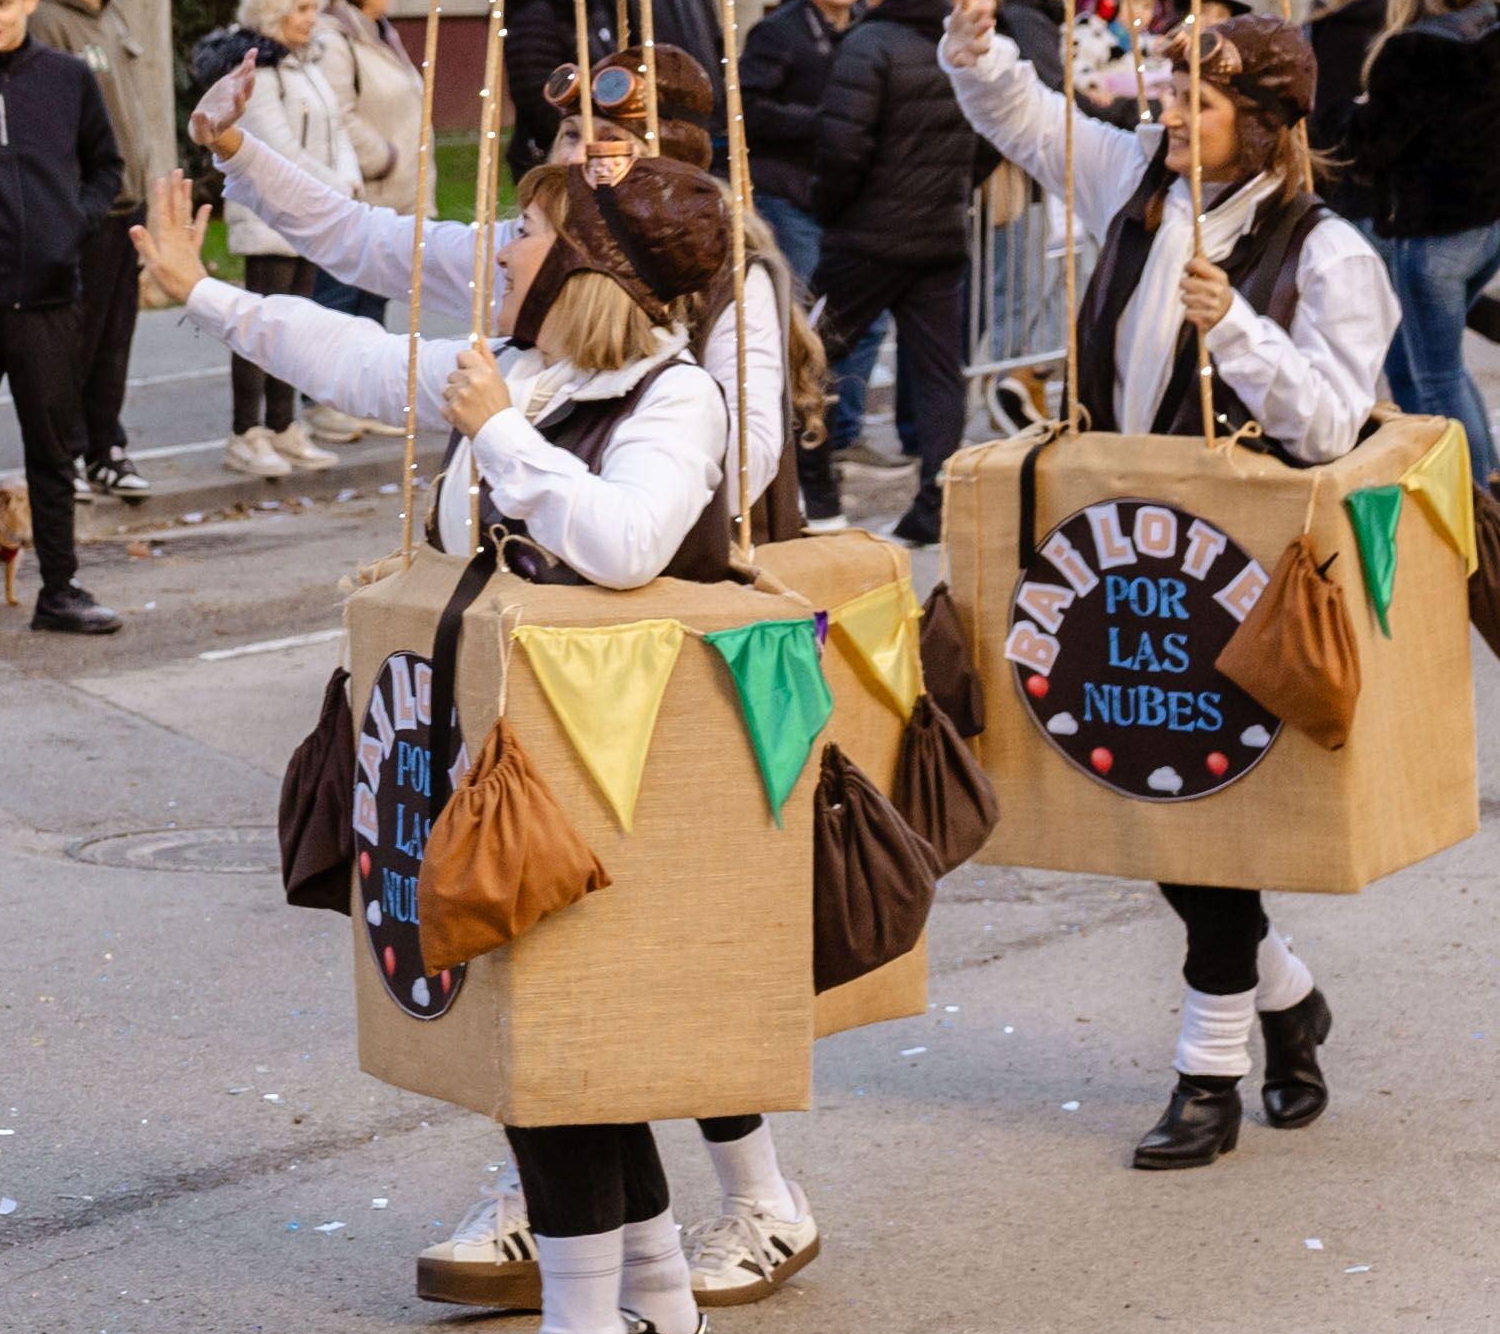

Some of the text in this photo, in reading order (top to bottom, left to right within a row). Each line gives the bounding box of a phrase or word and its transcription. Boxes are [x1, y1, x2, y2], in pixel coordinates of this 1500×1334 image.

[1105, 575, 1190, 619] POR
[1108, 627, 1190, 673] LAS
[1083, 682, 1224, 732] NUBES
[396, 803, 431, 860] LA
